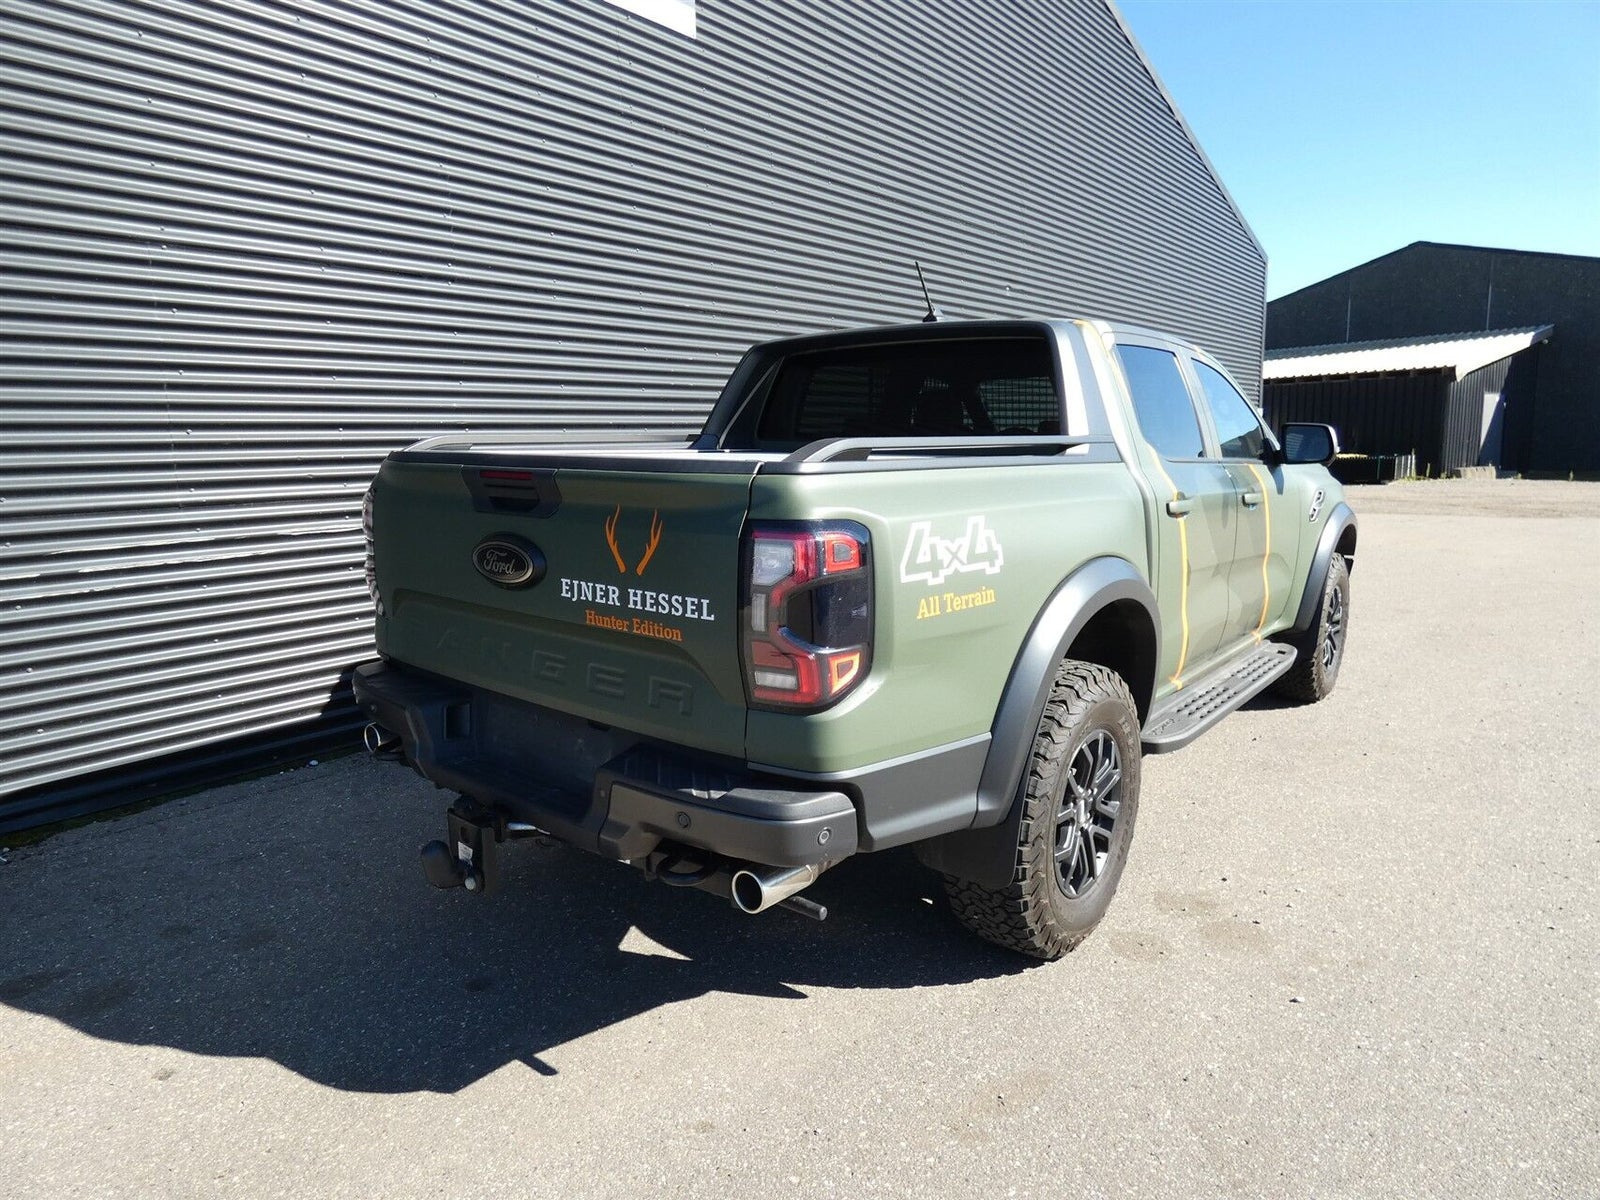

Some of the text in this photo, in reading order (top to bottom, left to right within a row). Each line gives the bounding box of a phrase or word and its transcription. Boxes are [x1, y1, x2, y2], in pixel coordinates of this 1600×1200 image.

[483, 549, 516, 574] Ford
[900, 515, 1004, 586] 4x4
[560, 578, 715, 621] EJNER HESSEL
[917, 586, 996, 619] All Terrain
[585, 609, 683, 642] Hunter Edition
